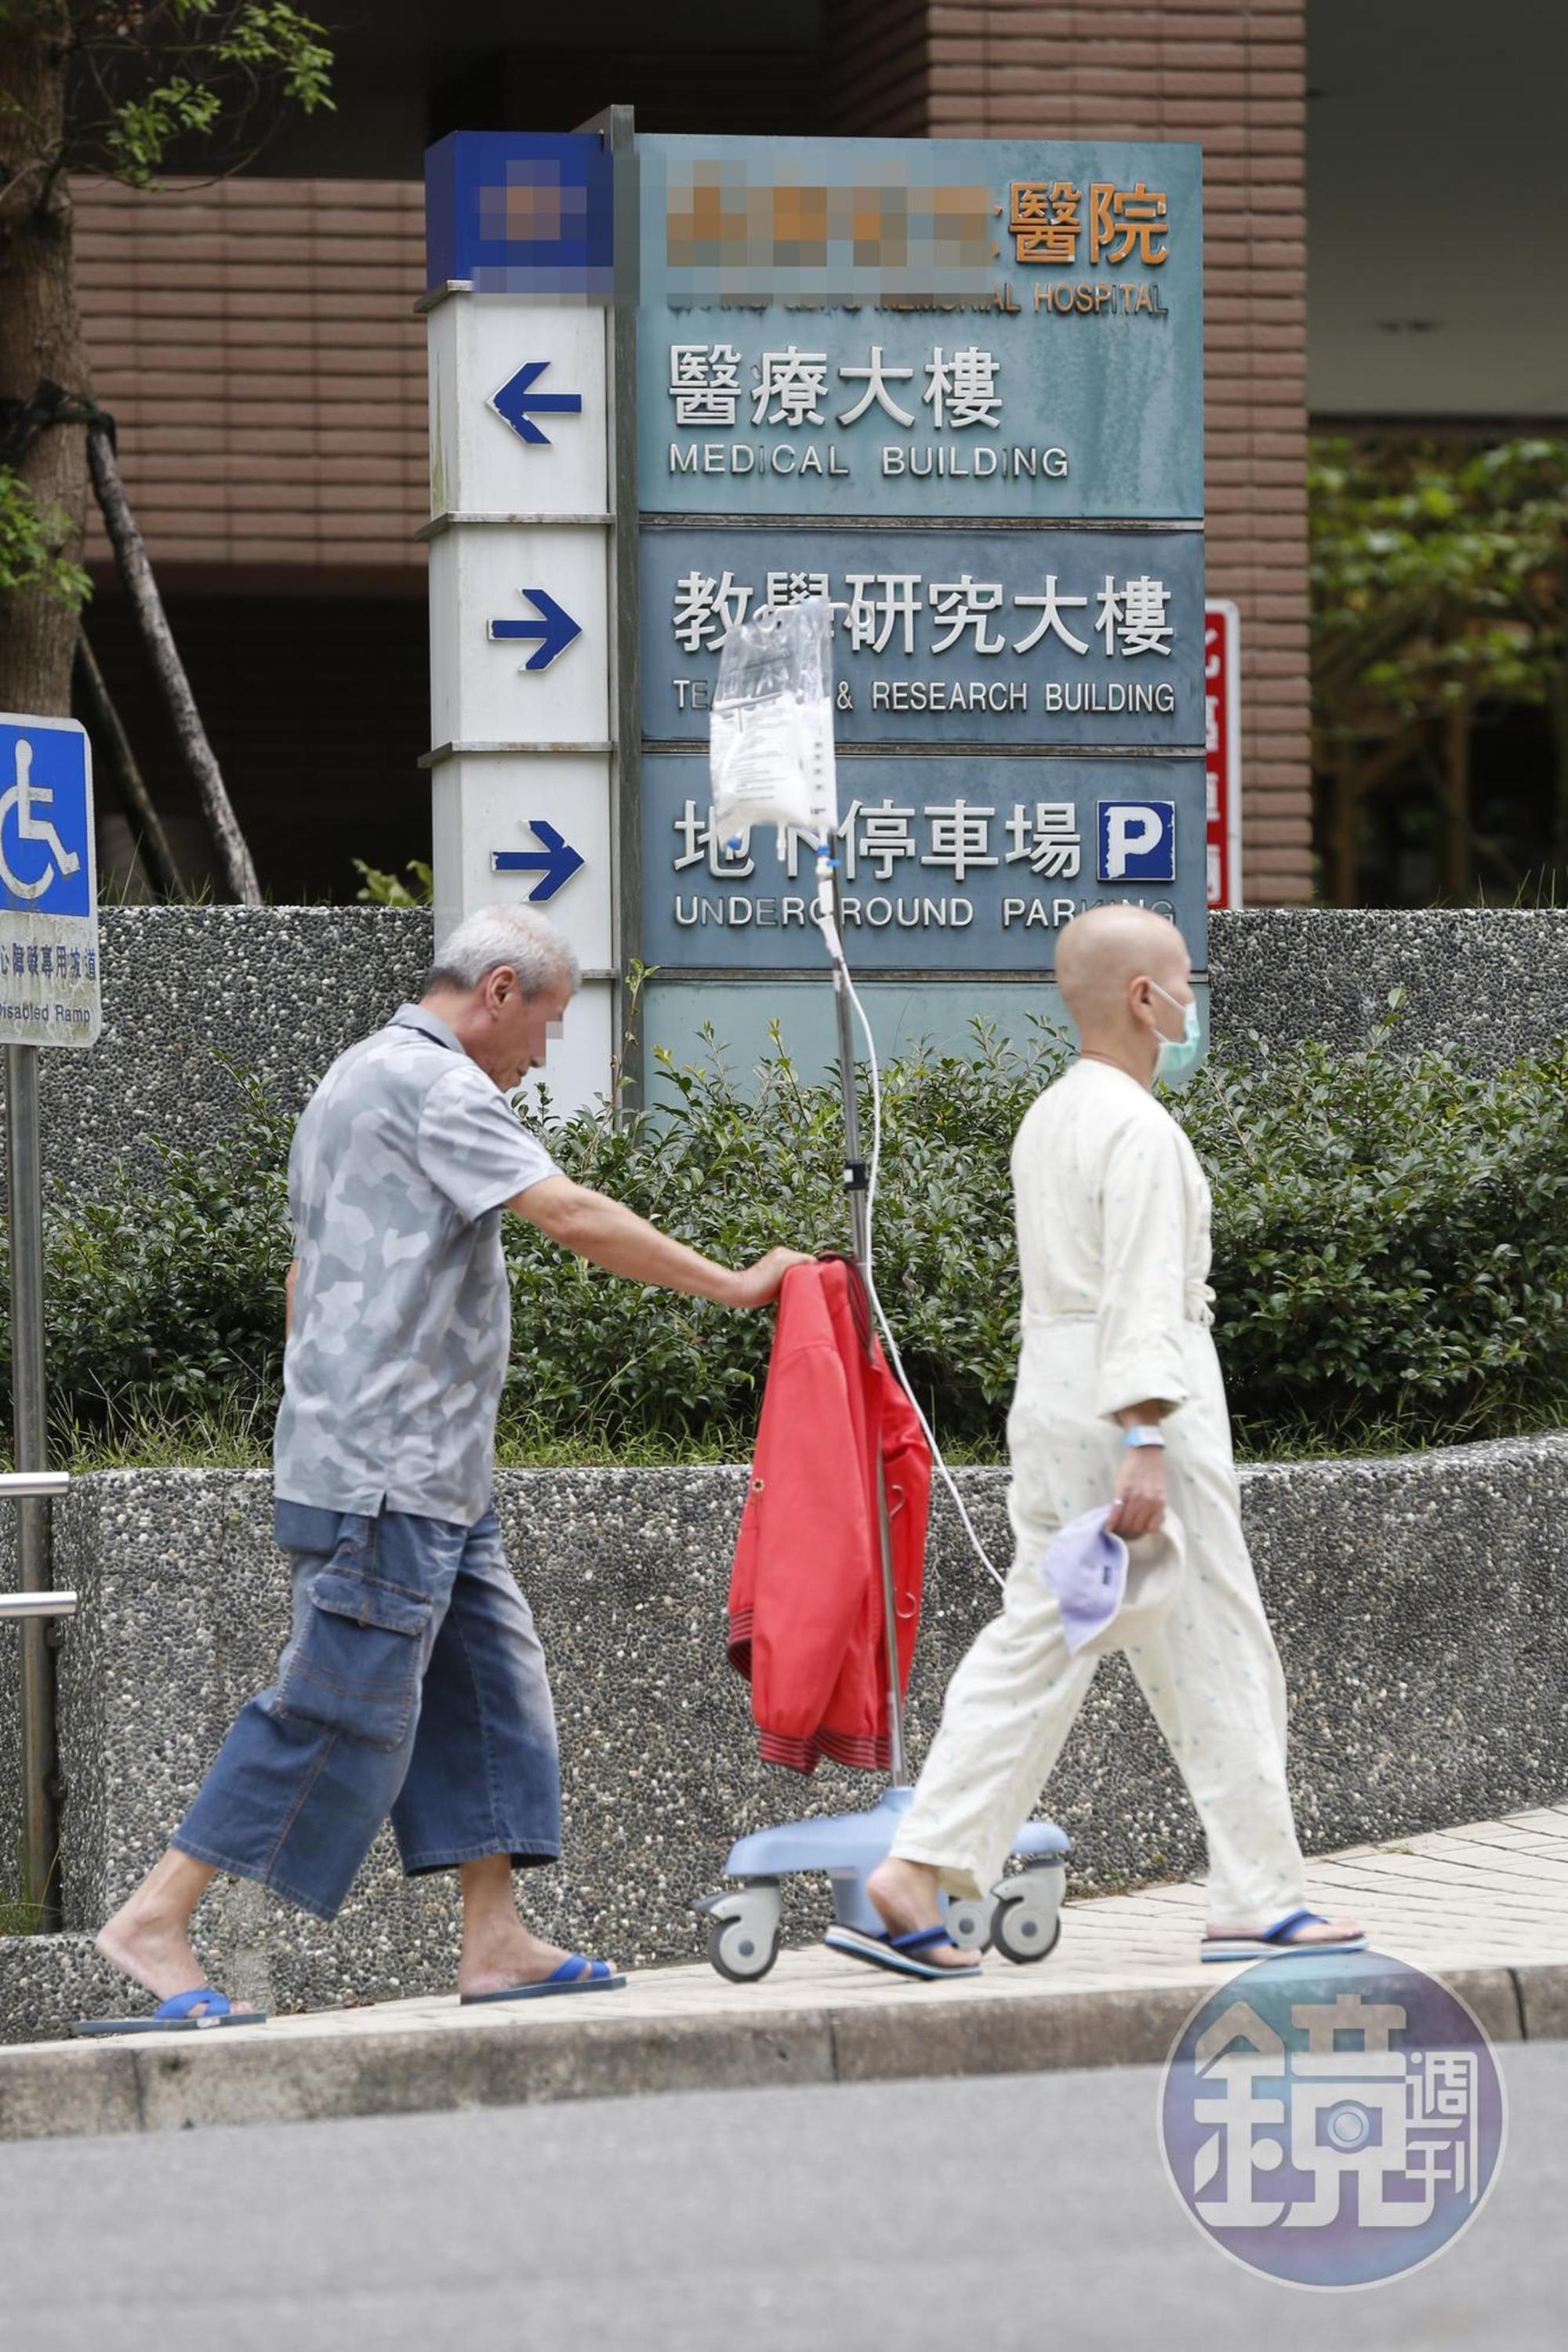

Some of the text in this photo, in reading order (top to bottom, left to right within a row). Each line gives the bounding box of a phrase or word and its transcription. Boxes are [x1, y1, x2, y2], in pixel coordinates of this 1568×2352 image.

[1033, 281, 1168, 314] HOSPITAL
[669, 344, 1004, 428] 醫療大樓
[670, 443, 1069, 477] MEDICAL BUILDING
[837, 681, 1175, 713] & RESEARCH BUILDING
[0, 1003, 91, 1027] isabled Ramp
